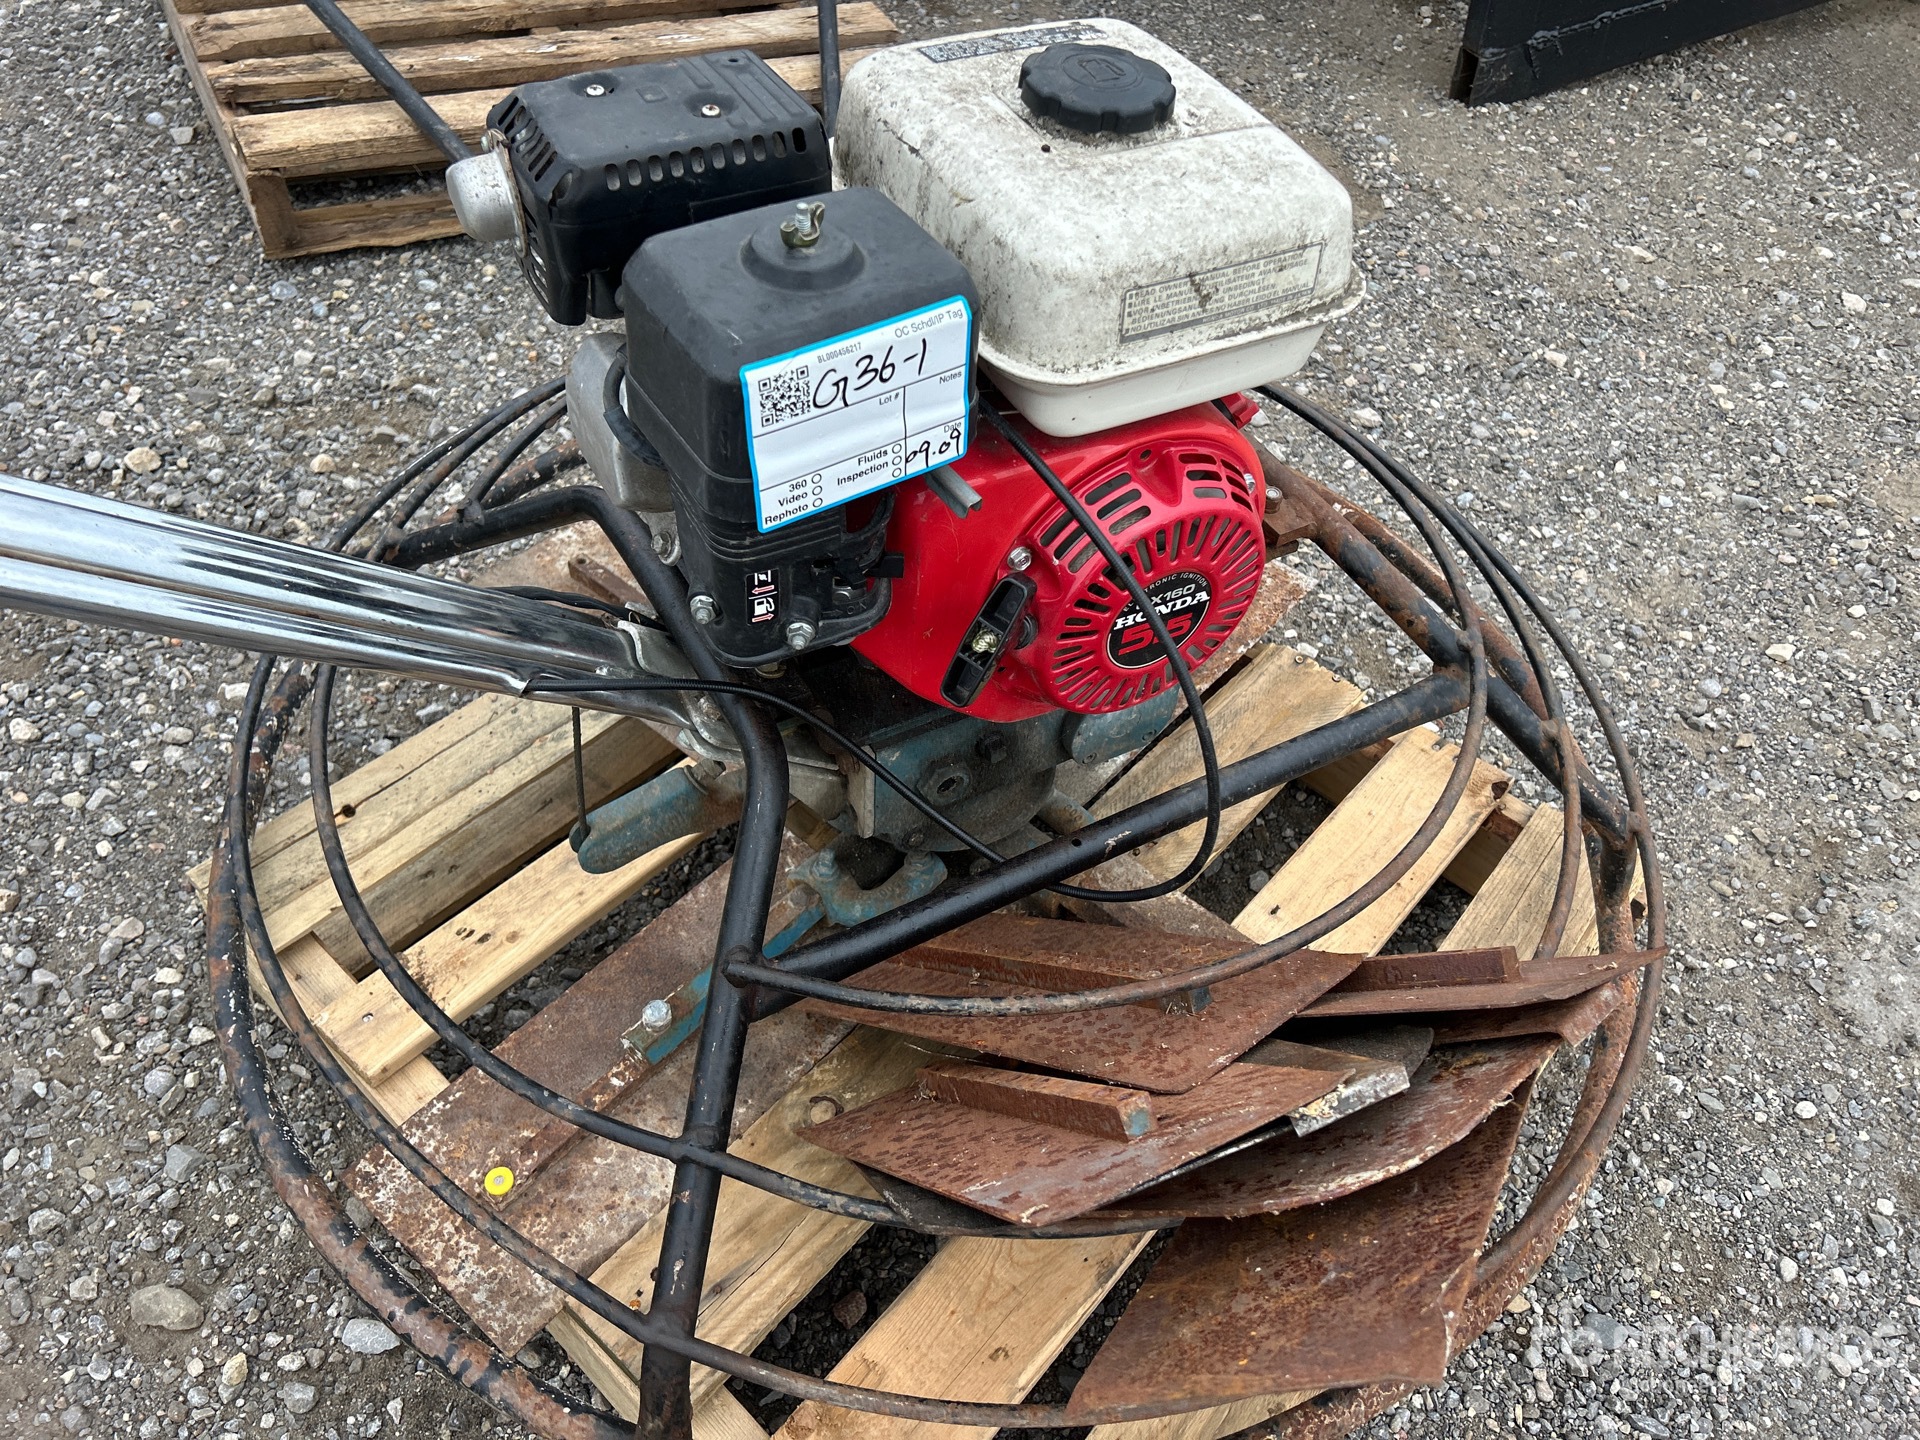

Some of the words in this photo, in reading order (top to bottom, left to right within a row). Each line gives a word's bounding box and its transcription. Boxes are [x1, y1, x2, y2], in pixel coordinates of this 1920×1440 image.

[1198, 270, 1230, 283] MANUAL
[1232, 262, 1260, 275] BEFORE
[1153, 295, 1162, 303] LE
[1165, 286, 1199, 300] MANUE
[1222, 278, 1265, 294] UNBEDINGT
[1226, 297, 1250, 308] HABER
[894, 327, 910, 338] OC
[945, 308, 964, 320] Tag
[817, 342, 862, 364] BL000456217
[938, 370, 962, 385] Notes
[879, 394, 893, 406] Lot
[943, 421, 962, 434] Date
[857, 449, 889, 467] Fluids
[836, 462, 889, 486] Inspection
[788, 479, 808, 493] 360
[777, 491, 808, 507] Video
[764, 504, 809, 525] Rephoto
[1123, 573, 1178, 612] ELTRONIC
[1179, 571, 1208, 587] IGNITION
